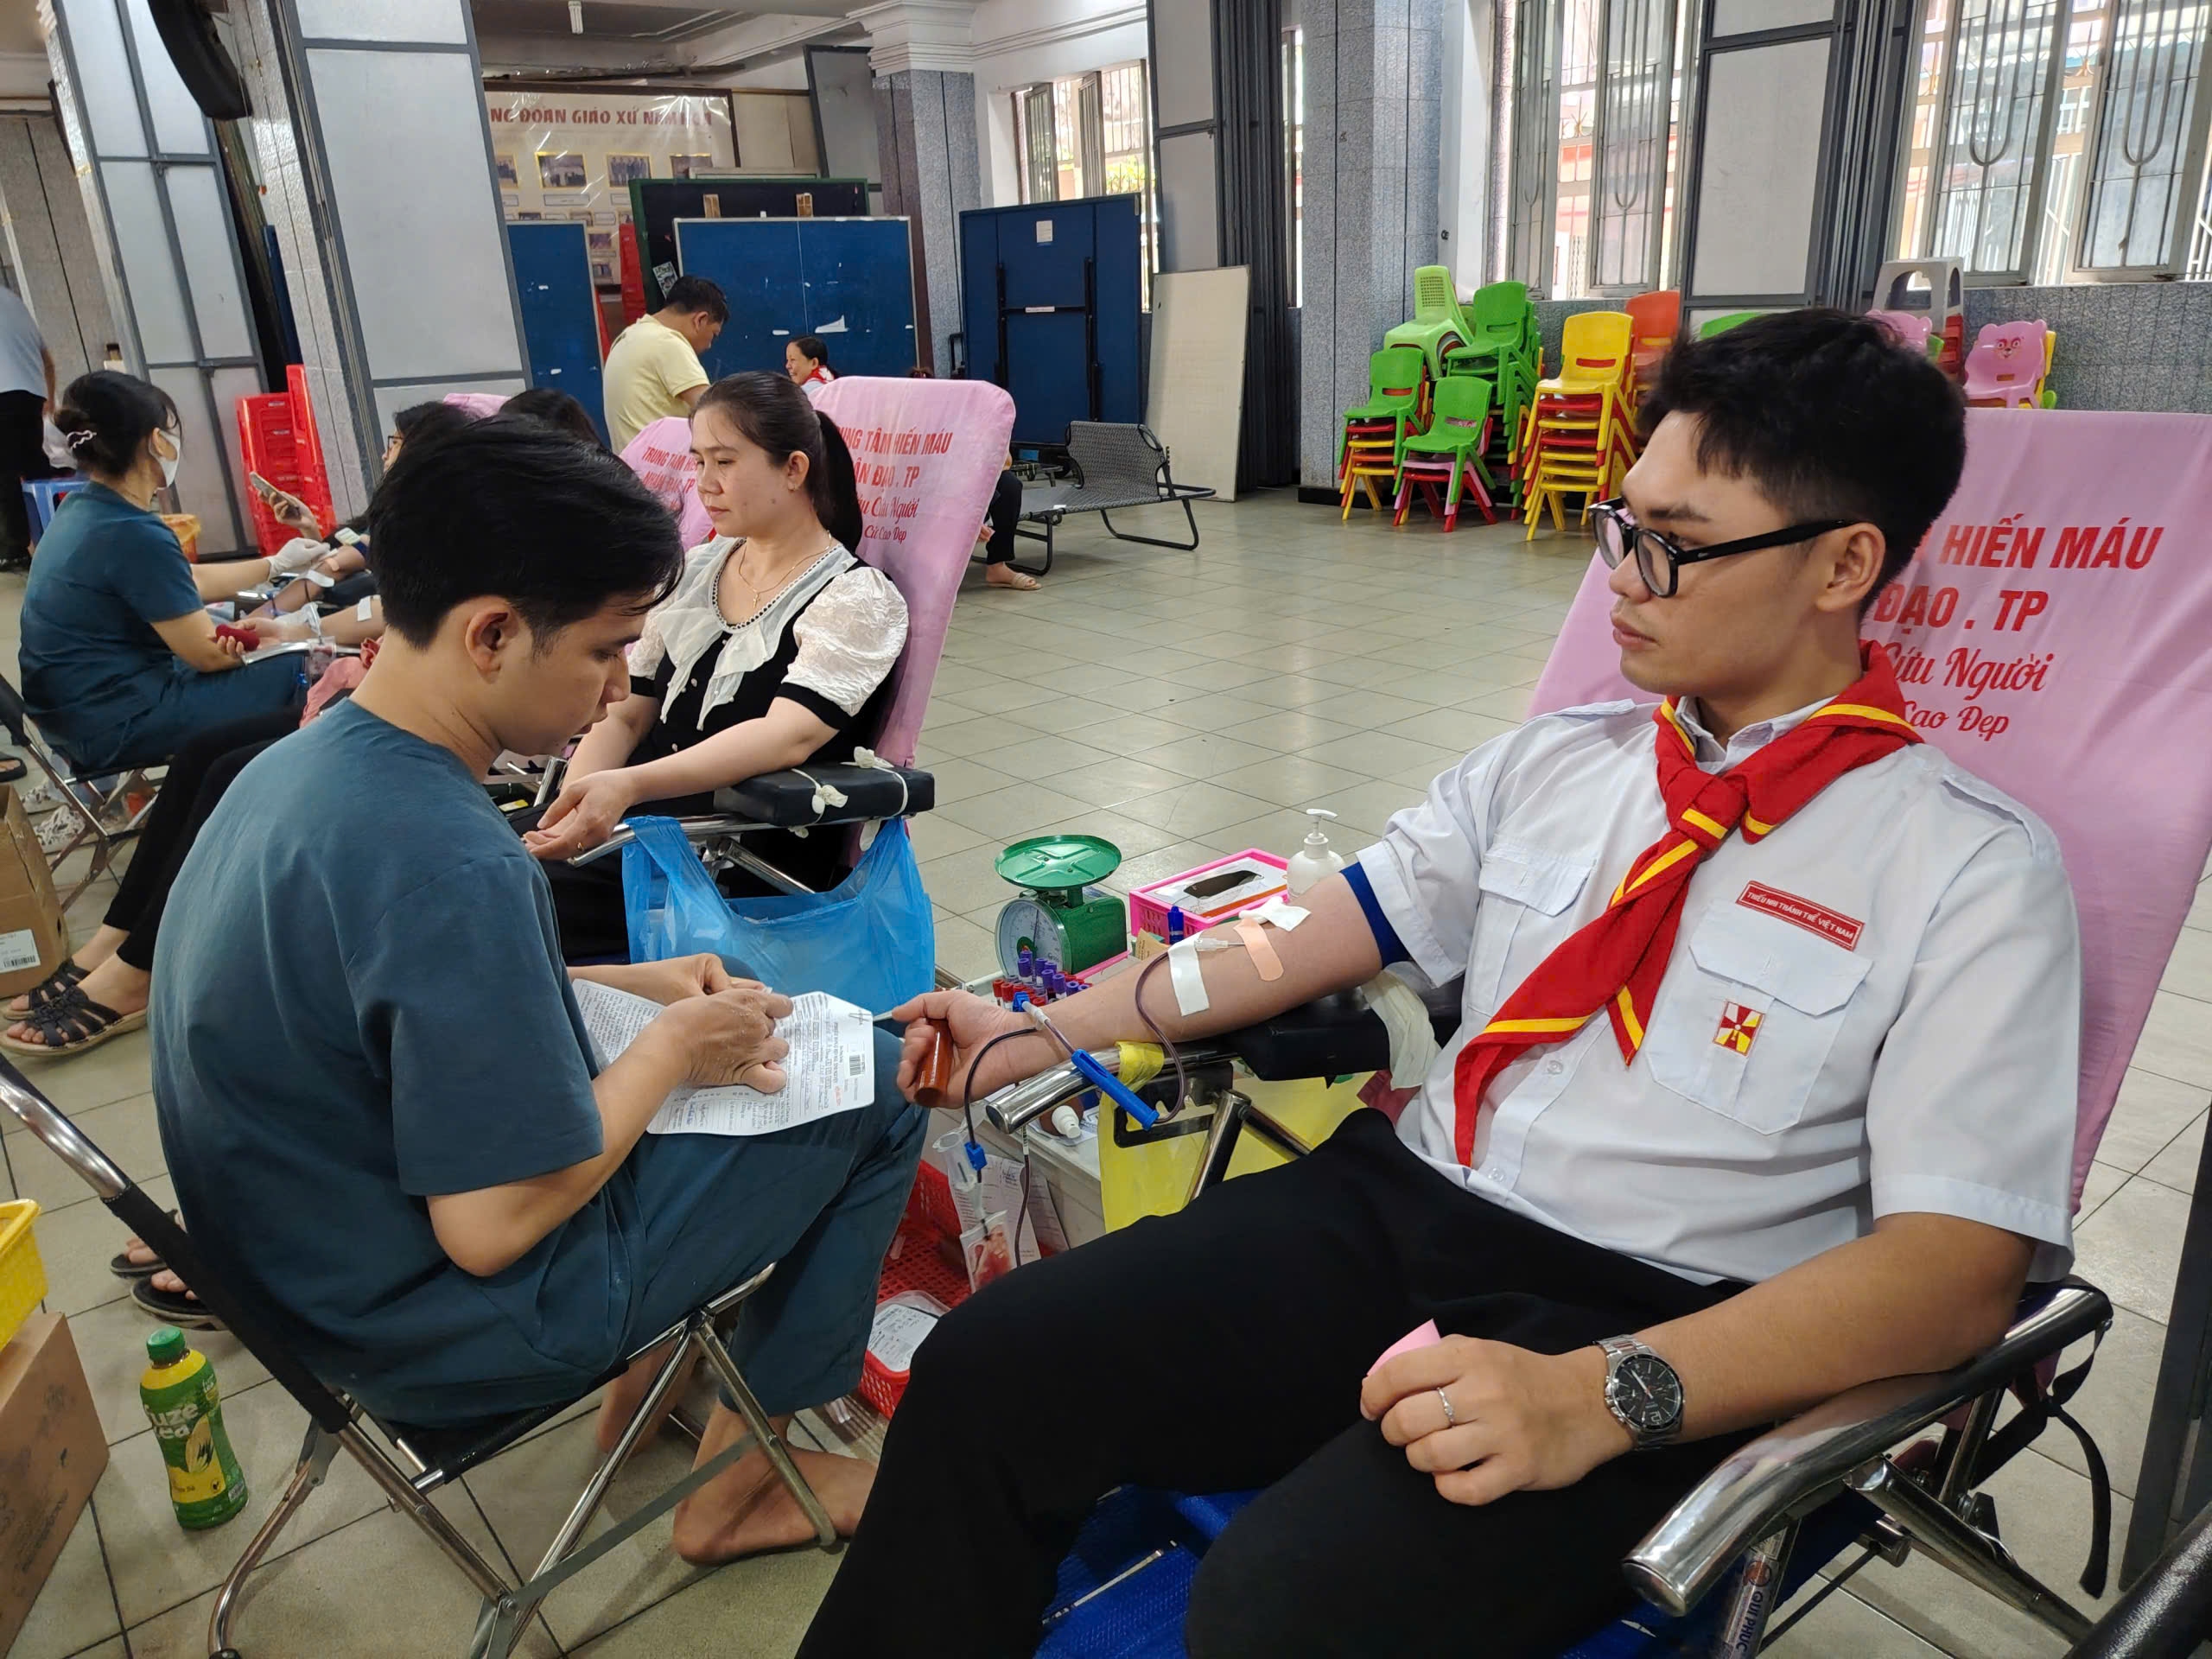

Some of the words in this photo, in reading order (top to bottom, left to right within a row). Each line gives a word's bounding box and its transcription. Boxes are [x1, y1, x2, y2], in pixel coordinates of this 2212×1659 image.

[572, 105, 611, 125] GIÁO
[616, 105, 640, 125] XỨ
[837, 426, 863, 450] UNG
[864, 427, 893, 455] TÂM
[893, 426, 922, 456] HIẾN
[921, 429, 954, 456] MÁU
[642, 446, 671, 467] TRUNG
[871, 464, 896, 493] ĐẠO
[903, 466, 920, 488] TP
[890, 496, 920, 524] Người
[1938, 512, 2046, 569] HIẾN
[2049, 517, 2164, 570] MÁU
[1873, 582, 1960, 635] ĐẠO
[1993, 589, 2049, 632] TP
[1942, 647, 2055, 702] Người
[1956, 705, 2010, 742] Đẹp
[1836, 927, 1854, 939] NAM
